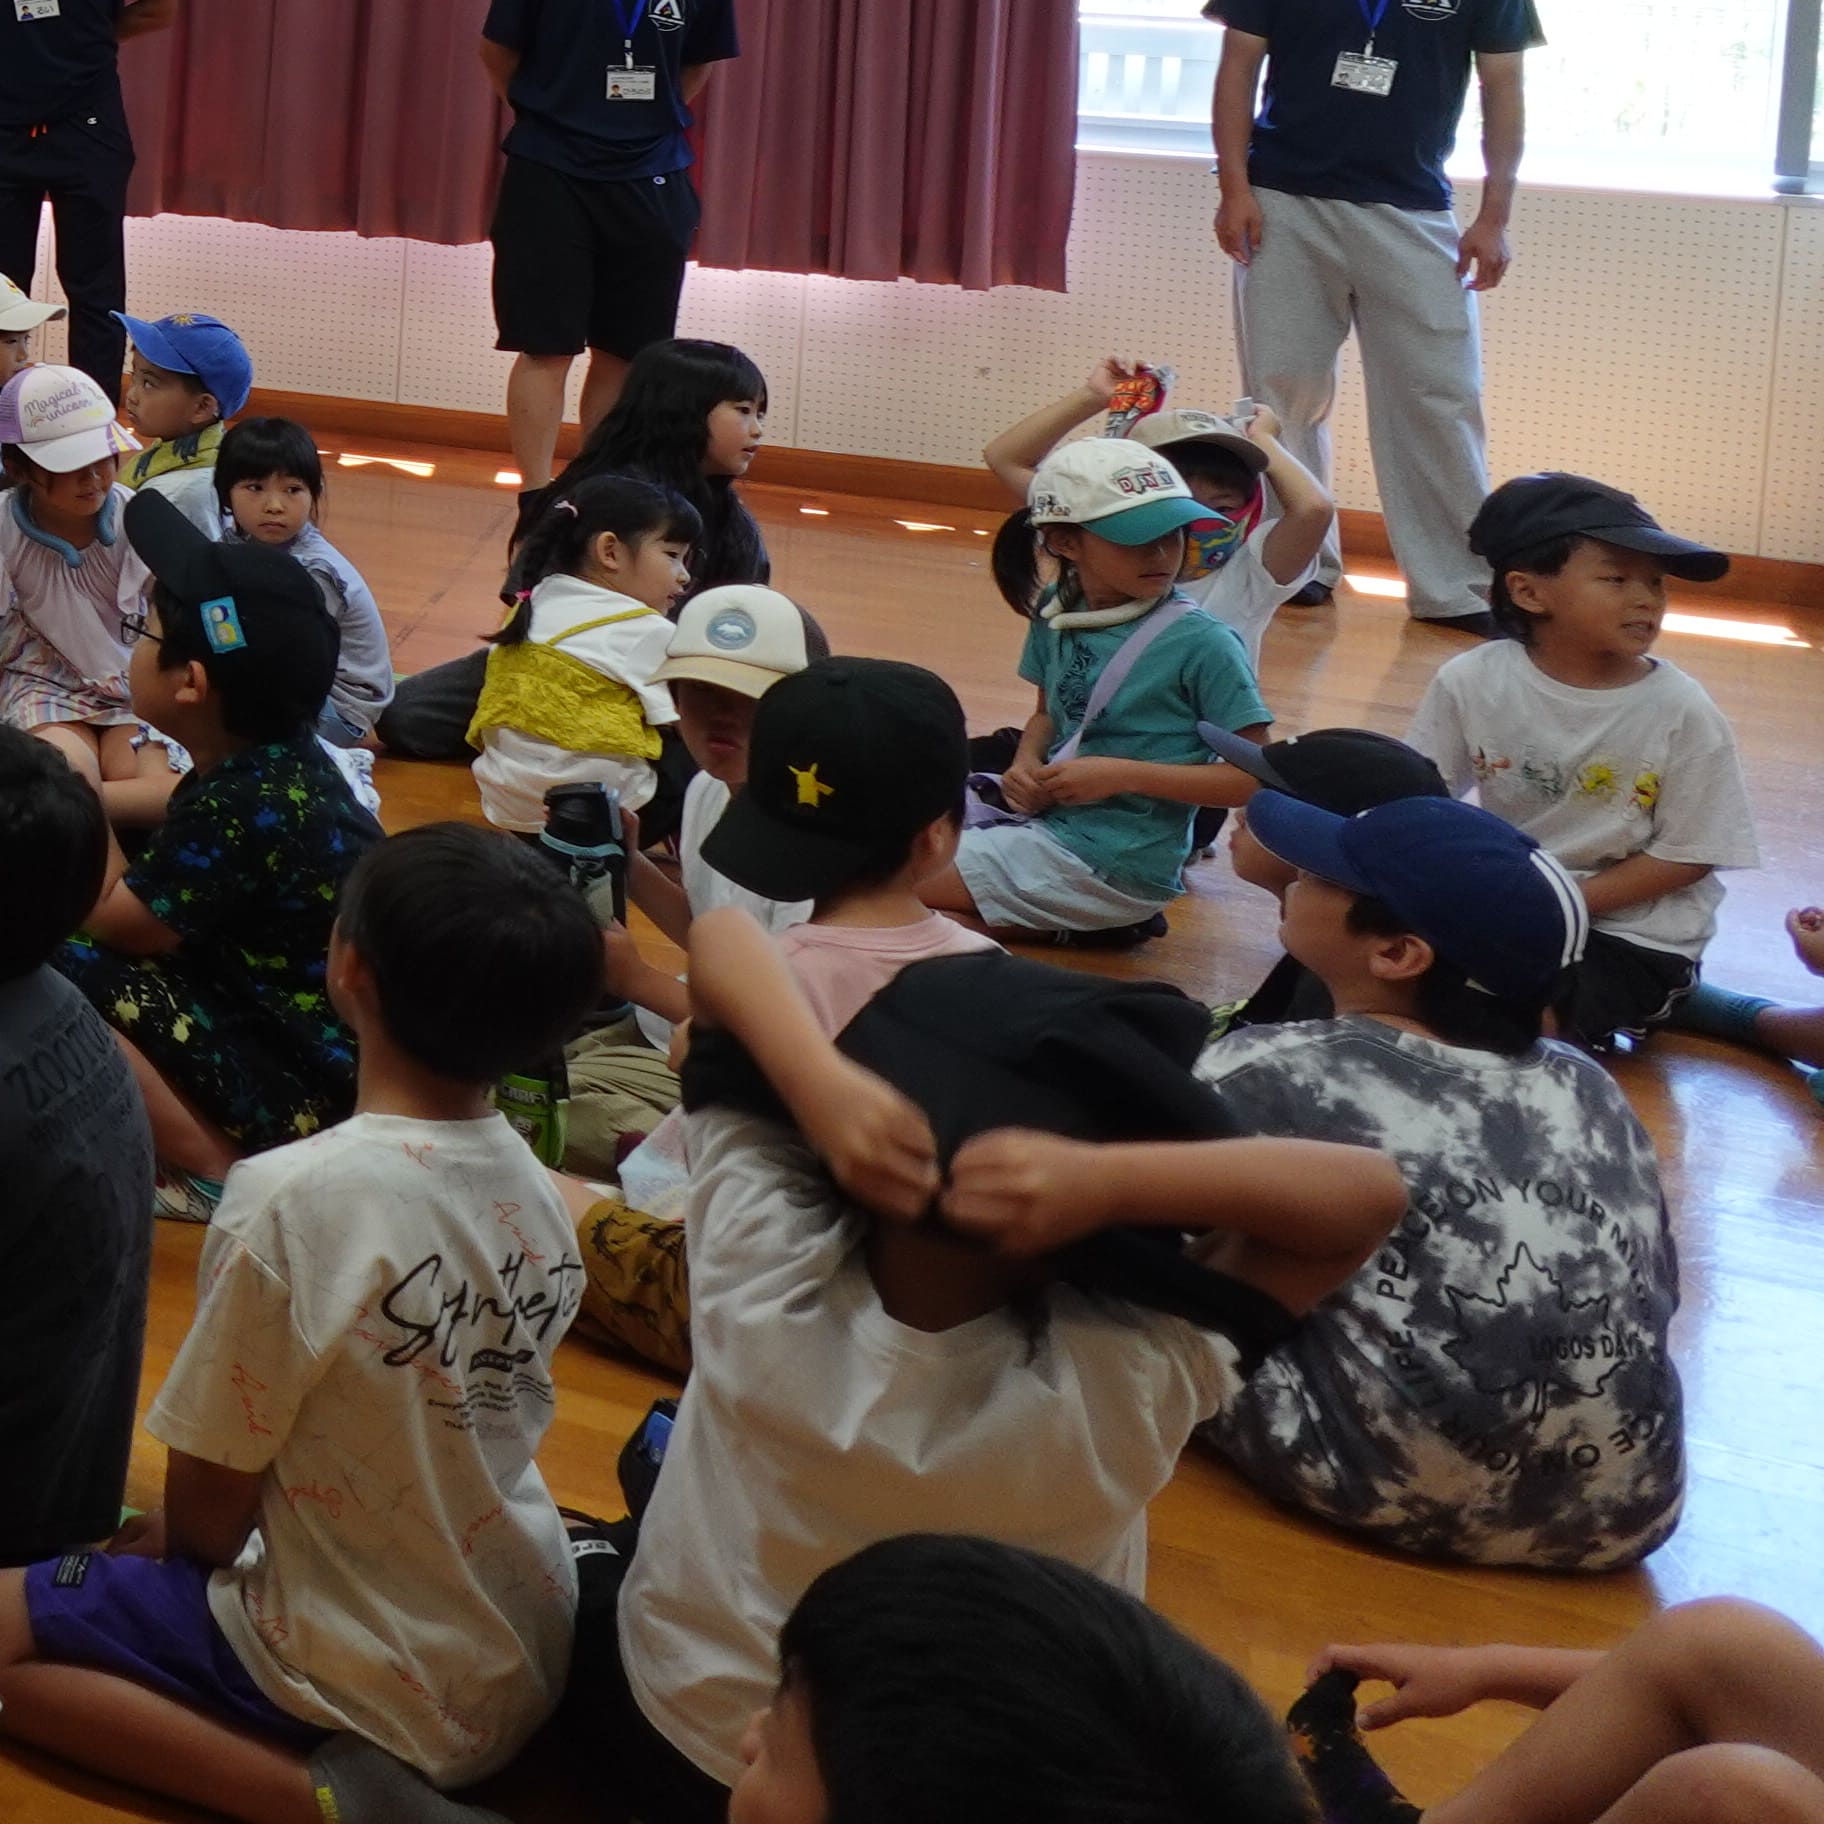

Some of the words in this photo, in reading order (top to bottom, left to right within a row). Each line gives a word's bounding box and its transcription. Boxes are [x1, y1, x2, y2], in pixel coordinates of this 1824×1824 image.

[24, 383, 80, 417] Magical
[1376, 1193, 1449, 1303] PEACE
[1446, 1177, 1505, 1210] ON
[1515, 1179, 1607, 1231] YOUR
[1530, 1333, 1596, 1361] LOGOS
